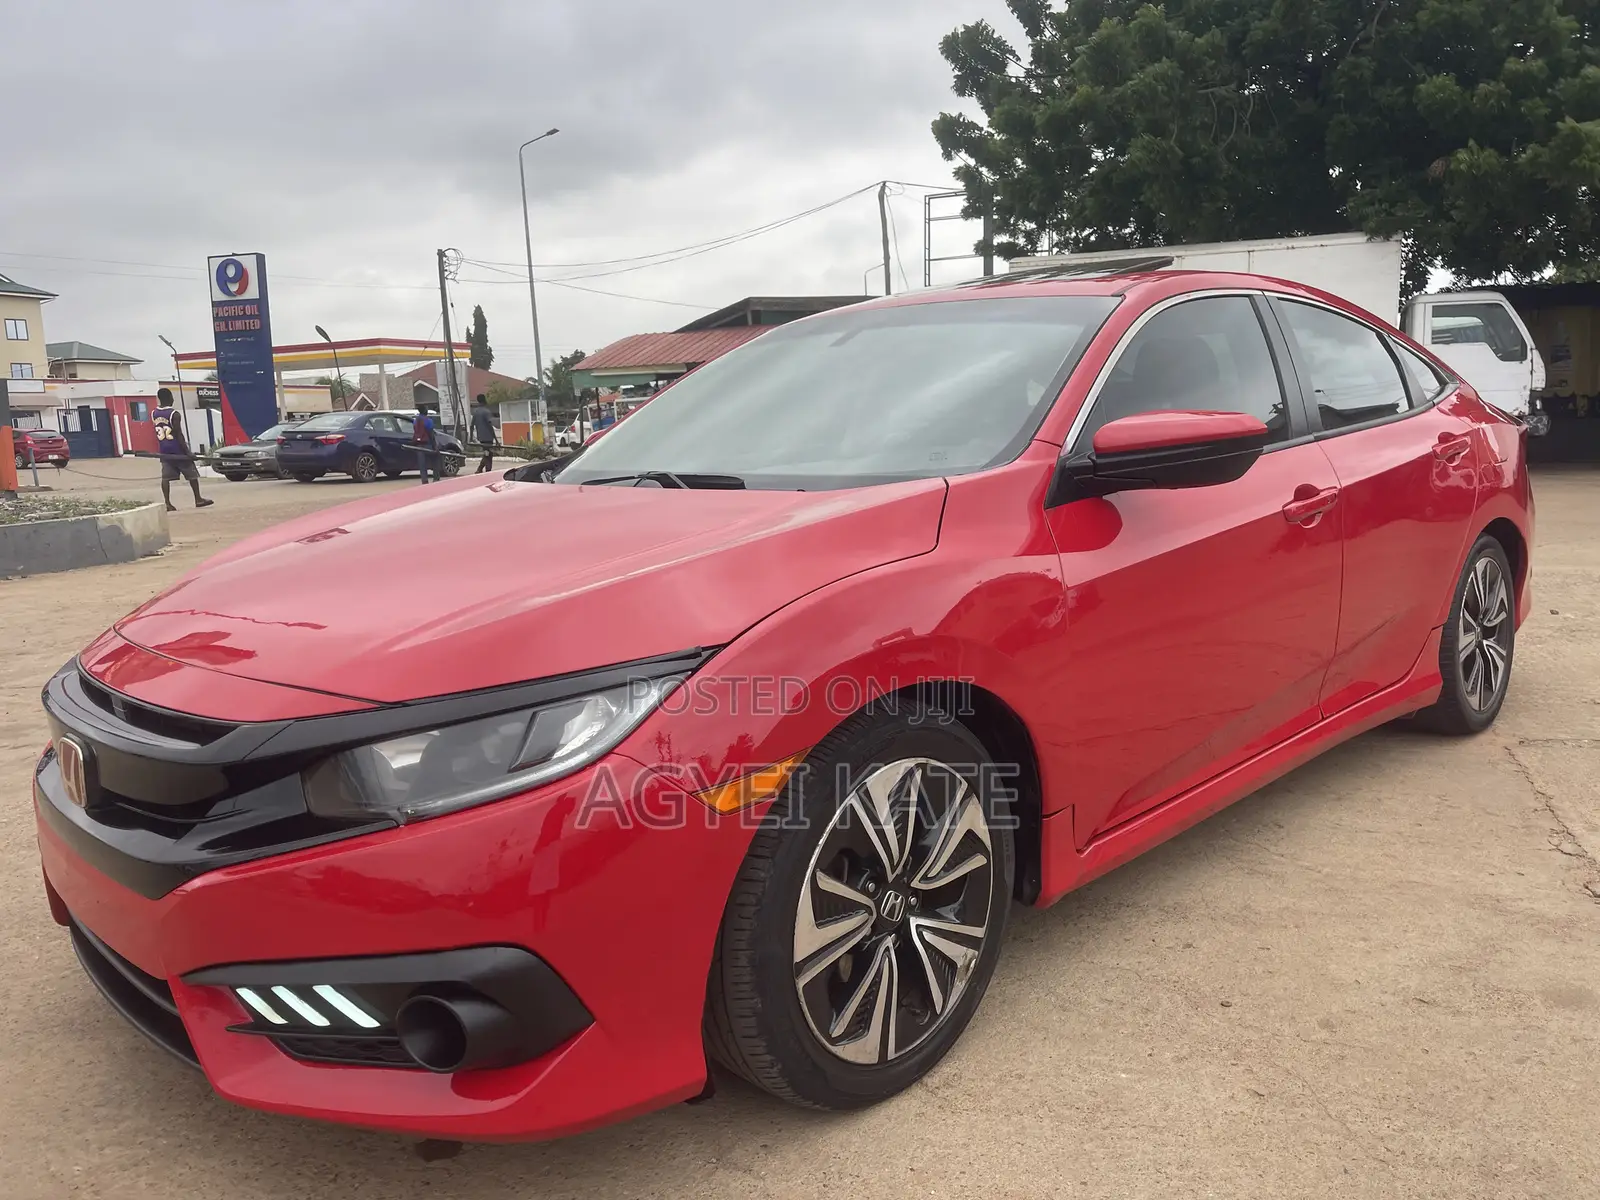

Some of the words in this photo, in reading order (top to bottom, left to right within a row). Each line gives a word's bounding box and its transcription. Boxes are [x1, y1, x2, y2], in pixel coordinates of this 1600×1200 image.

[213, 305, 244, 318] PACIFIC
[245, 304, 260, 316] OIL
[228, 319, 261, 331] LIMITED
[155, 425, 174, 441] 32
